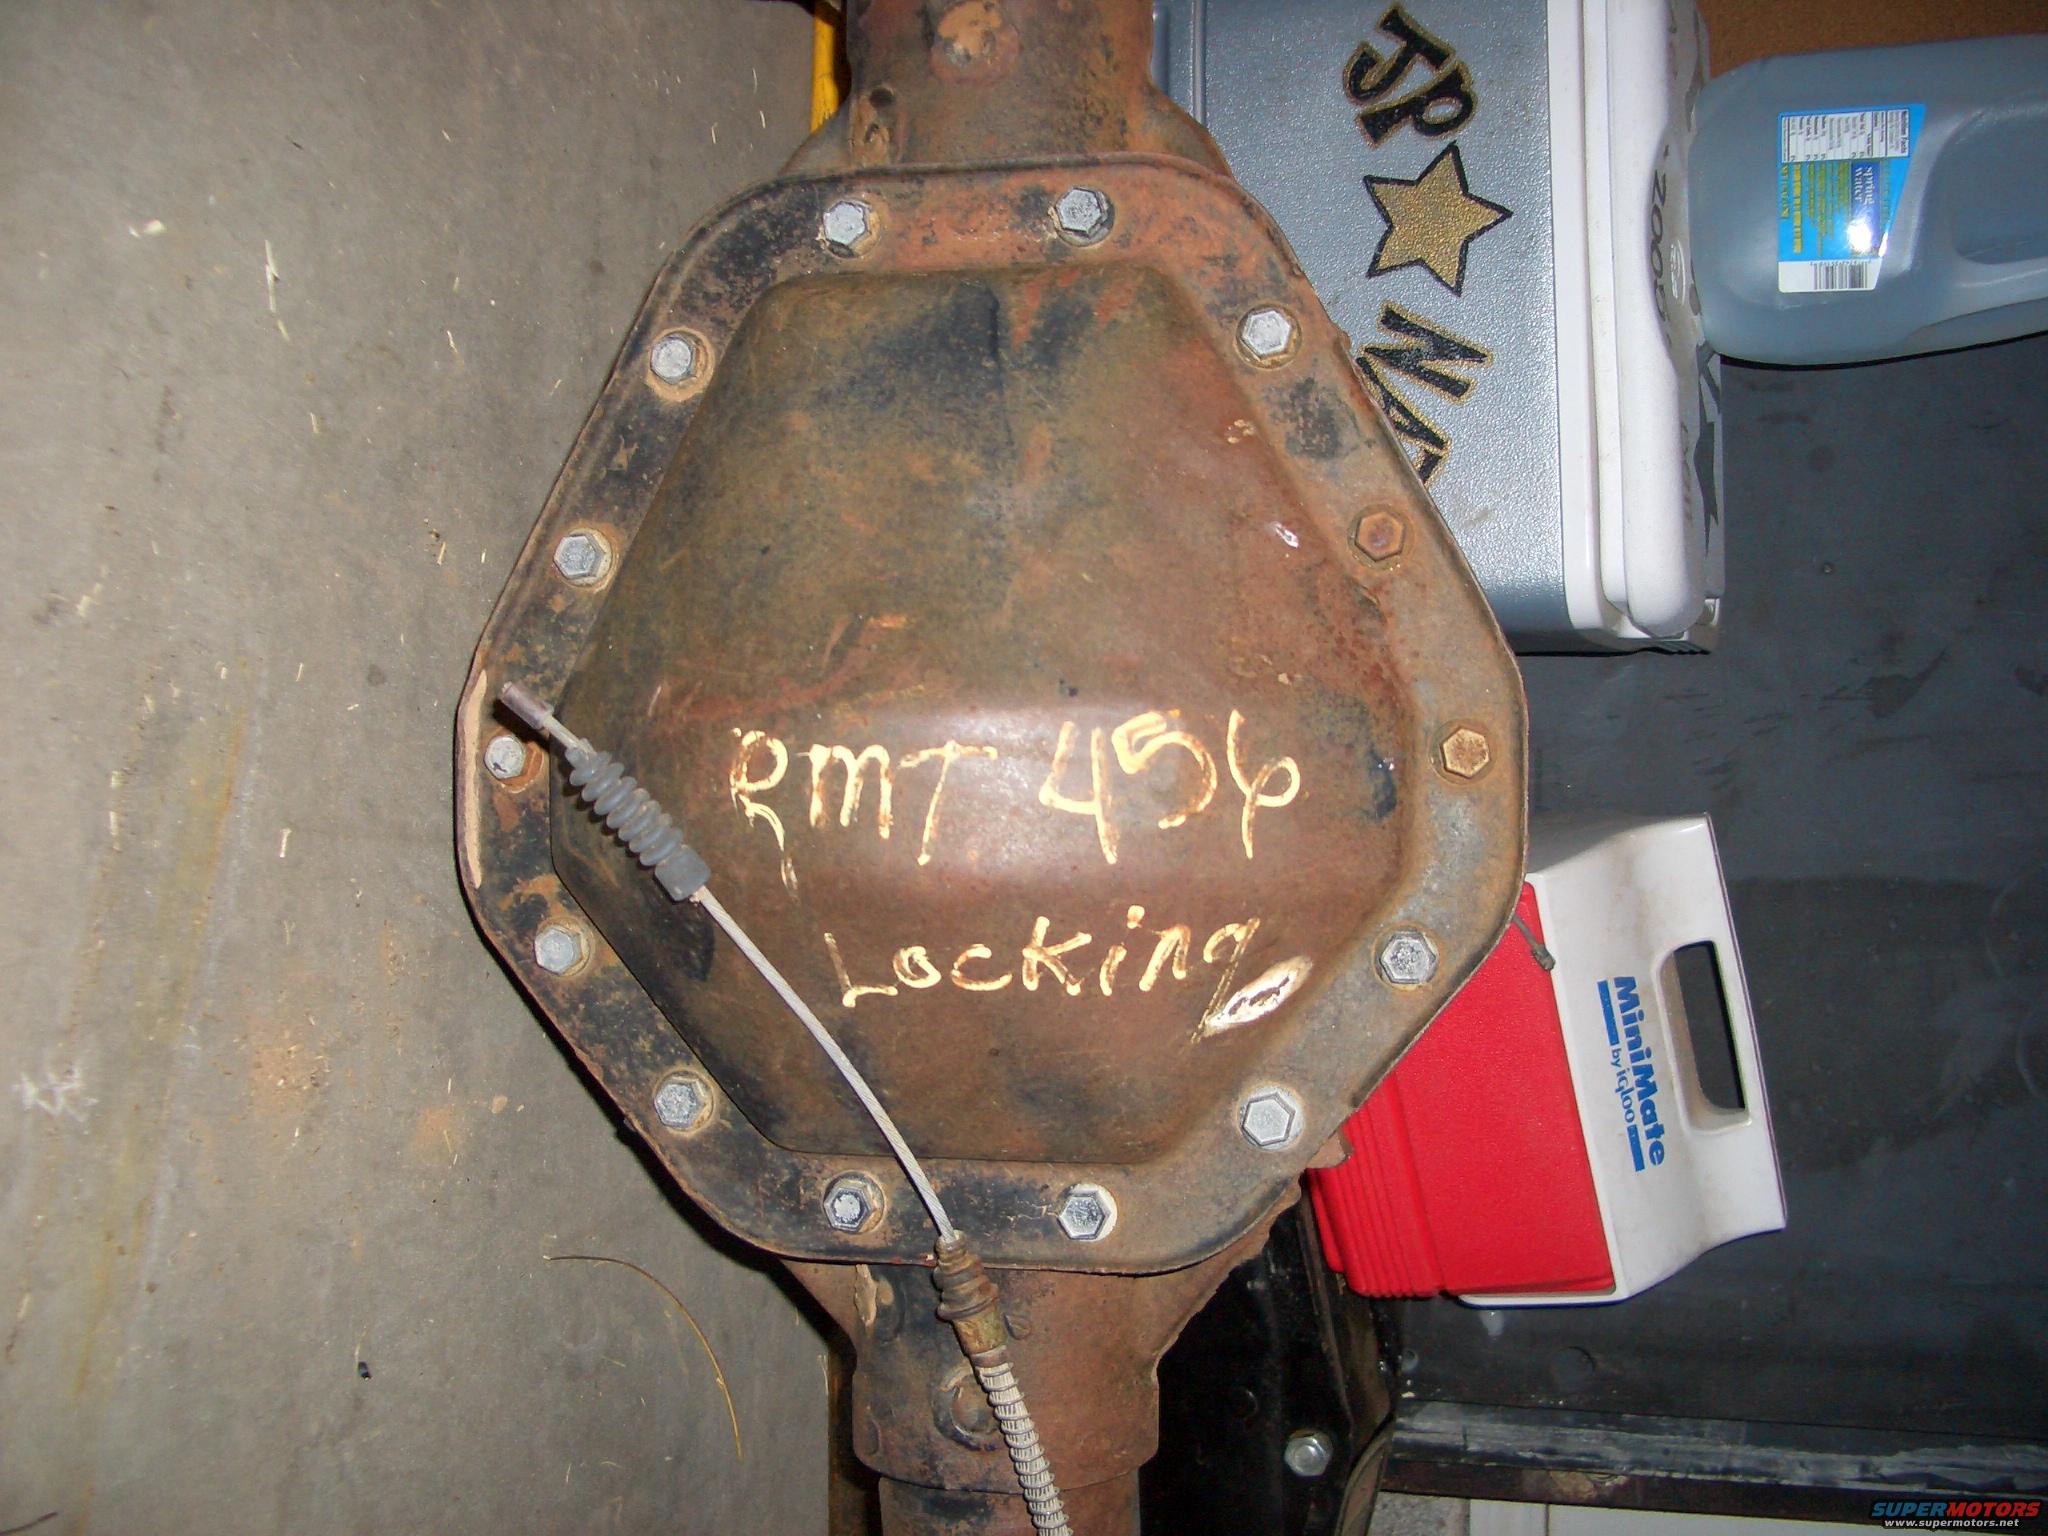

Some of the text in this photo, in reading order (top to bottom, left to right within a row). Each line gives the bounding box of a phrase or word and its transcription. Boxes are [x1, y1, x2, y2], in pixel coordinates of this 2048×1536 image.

[1854, 167, 1864, 203] water
[1861, 165, 1875, 206] spring
[1038, 709, 1301, 865] 456
[1611, 1048, 1622, 1068] by
[1614, 976, 1665, 1166] MiniMate
